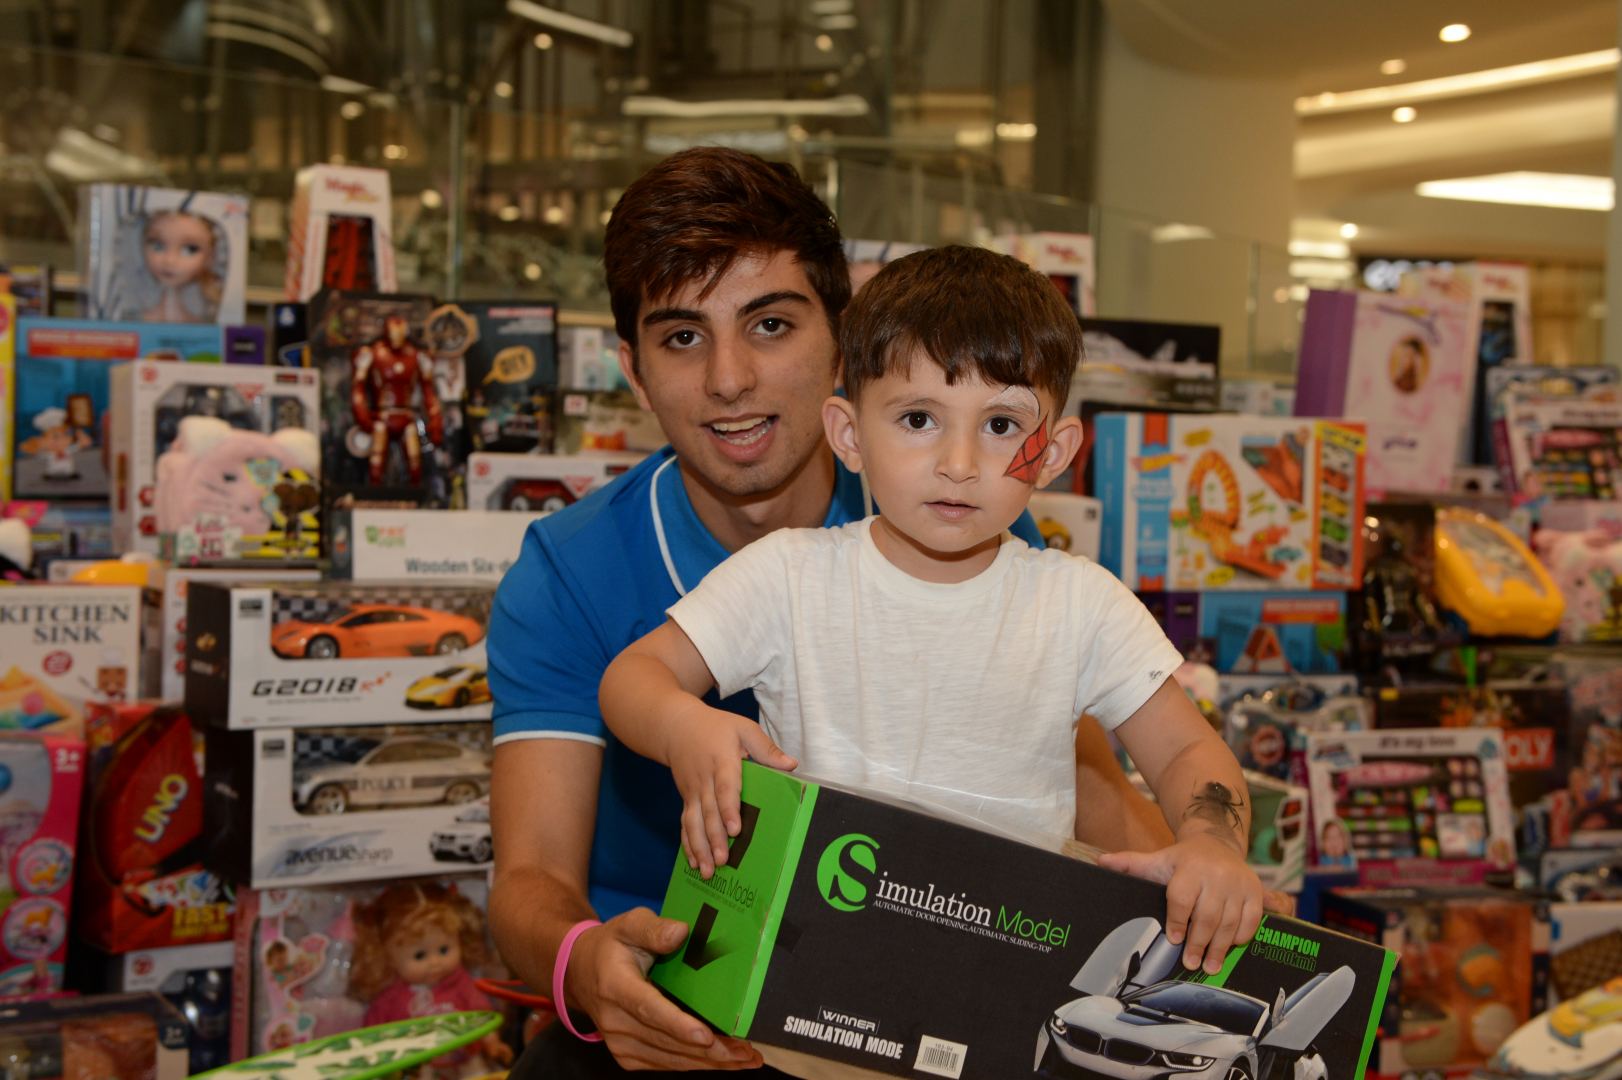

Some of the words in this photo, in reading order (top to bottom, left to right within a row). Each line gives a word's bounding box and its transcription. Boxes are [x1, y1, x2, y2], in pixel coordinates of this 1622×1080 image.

[404, 557, 468, 574] Wooden
[0, 604, 130, 623] KITCHEN
[33, 625, 102, 644] SINK
[251, 677, 358, 697] G2018
[1504, 734, 1552, 766] OLY
[134, 773, 189, 843] UNO
[872, 900, 915, 917] AUTOMATIC
[915, 910, 936, 922] DOOR
[996, 904, 1071, 948] Model
[1255, 926, 1321, 957] CHAMPION
[822, 1009, 876, 1032] WINNER
[784, 1015, 864, 1050] SIMULATION
[865, 1036, 904, 1060] MODE
